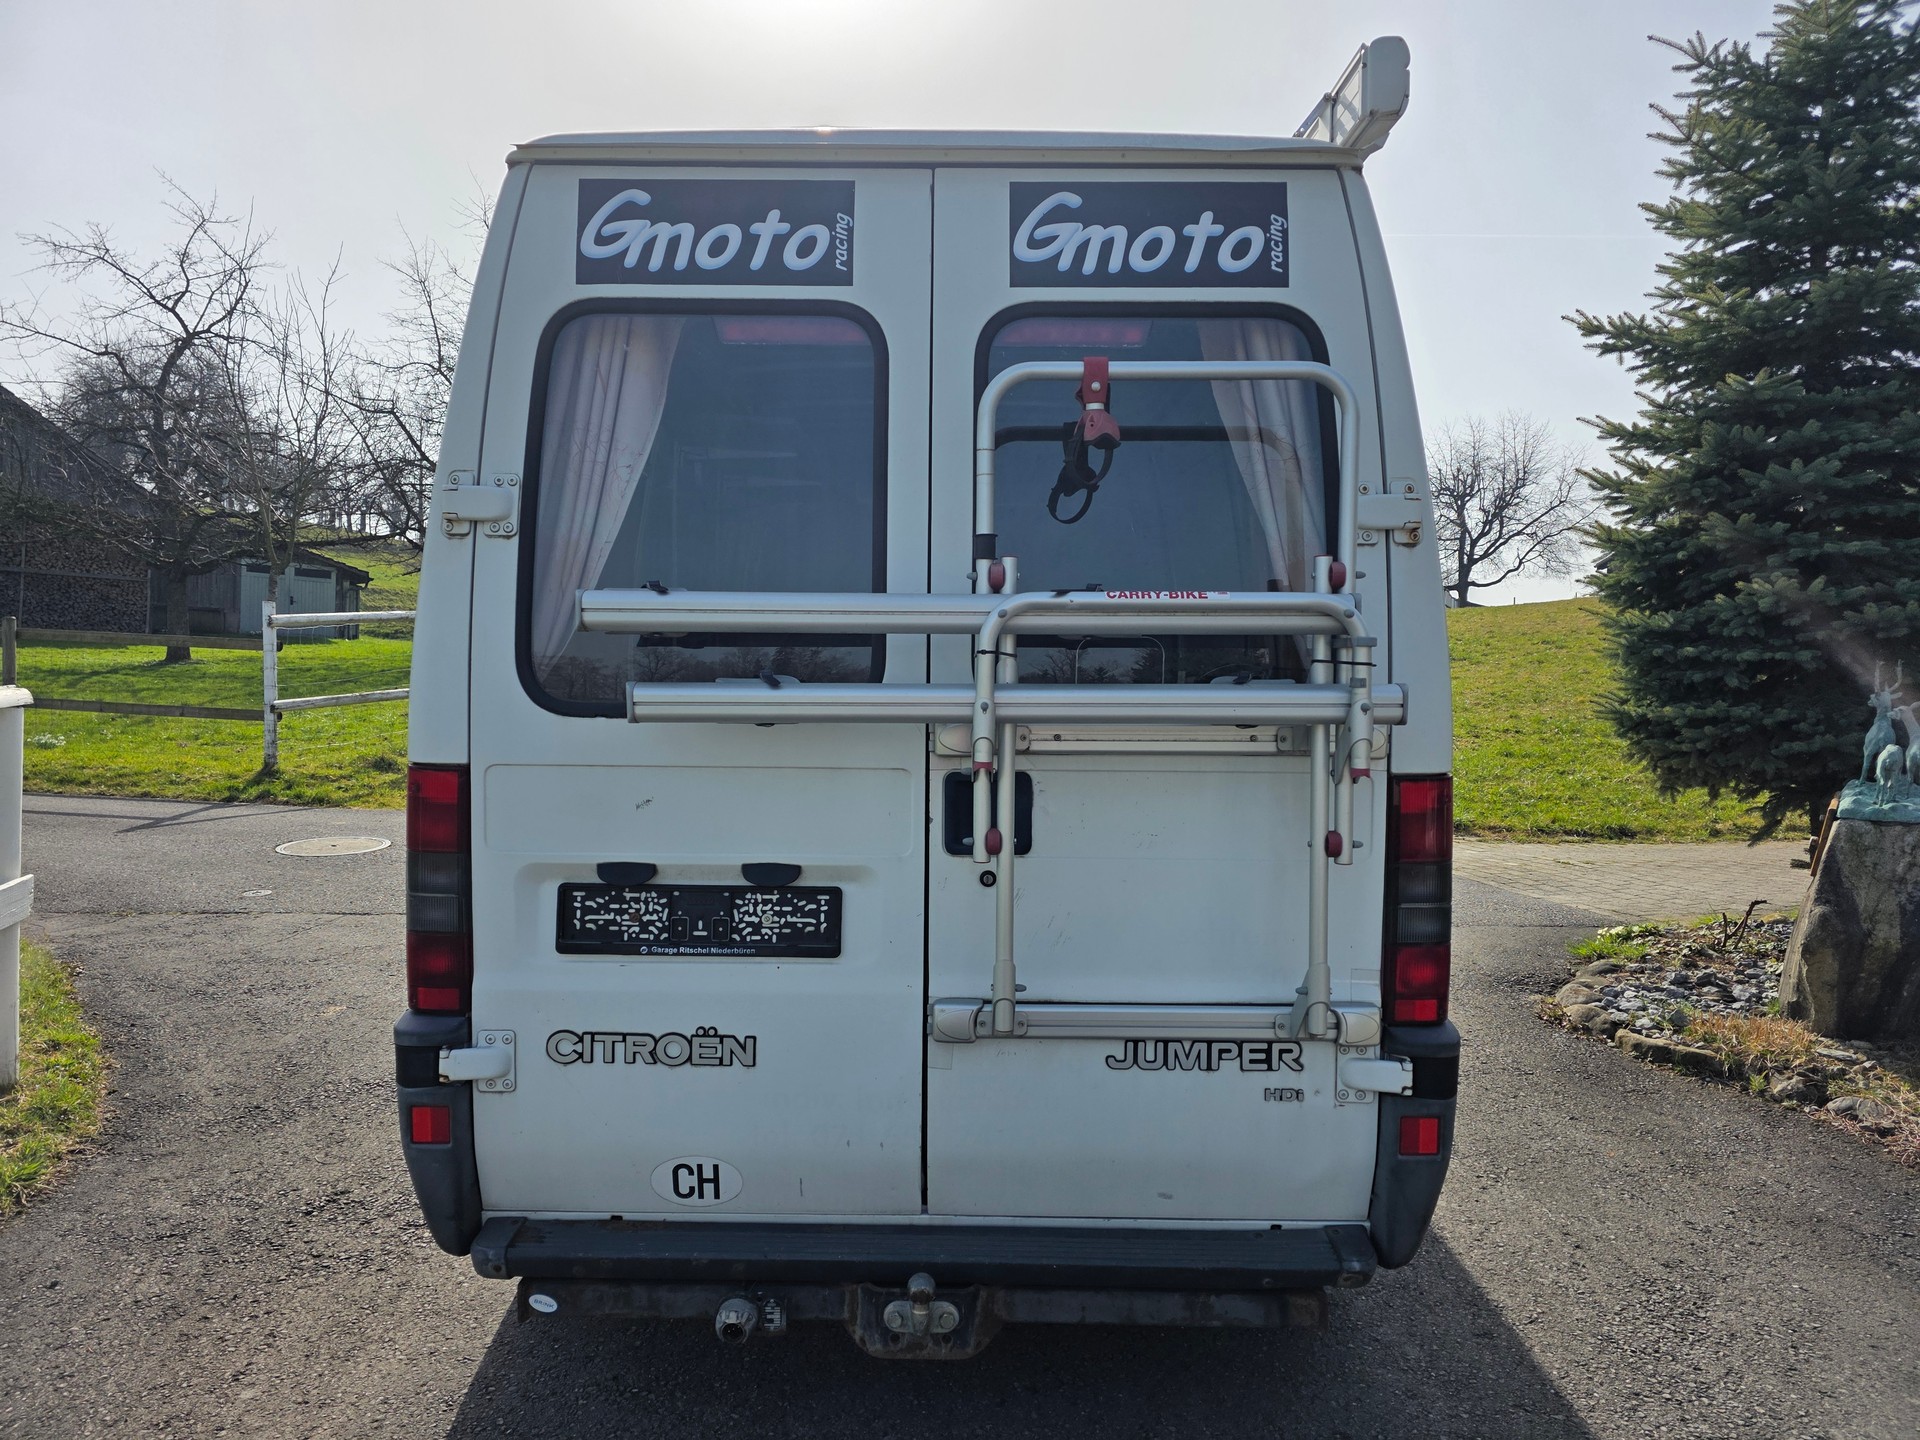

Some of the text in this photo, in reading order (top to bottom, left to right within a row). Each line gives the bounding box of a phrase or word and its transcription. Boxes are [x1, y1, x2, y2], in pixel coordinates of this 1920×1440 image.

[580, 188, 831, 272] Gmoto
[831, 212, 854, 271] racing
[1012, 191, 1265, 276] Gmoto
[1266, 213, 1288, 273] racing
[1106, 590, 1209, 600] CARRY-BIKE
[651, 945, 756, 955] Garage Ritschel Niederbüren
[546, 1026, 757, 1067] CITROËN
[1105, 1039, 1304, 1072] JUMPER
[1264, 1088, 1304, 1102] HDi
[671, 1163, 721, 1200] CH
